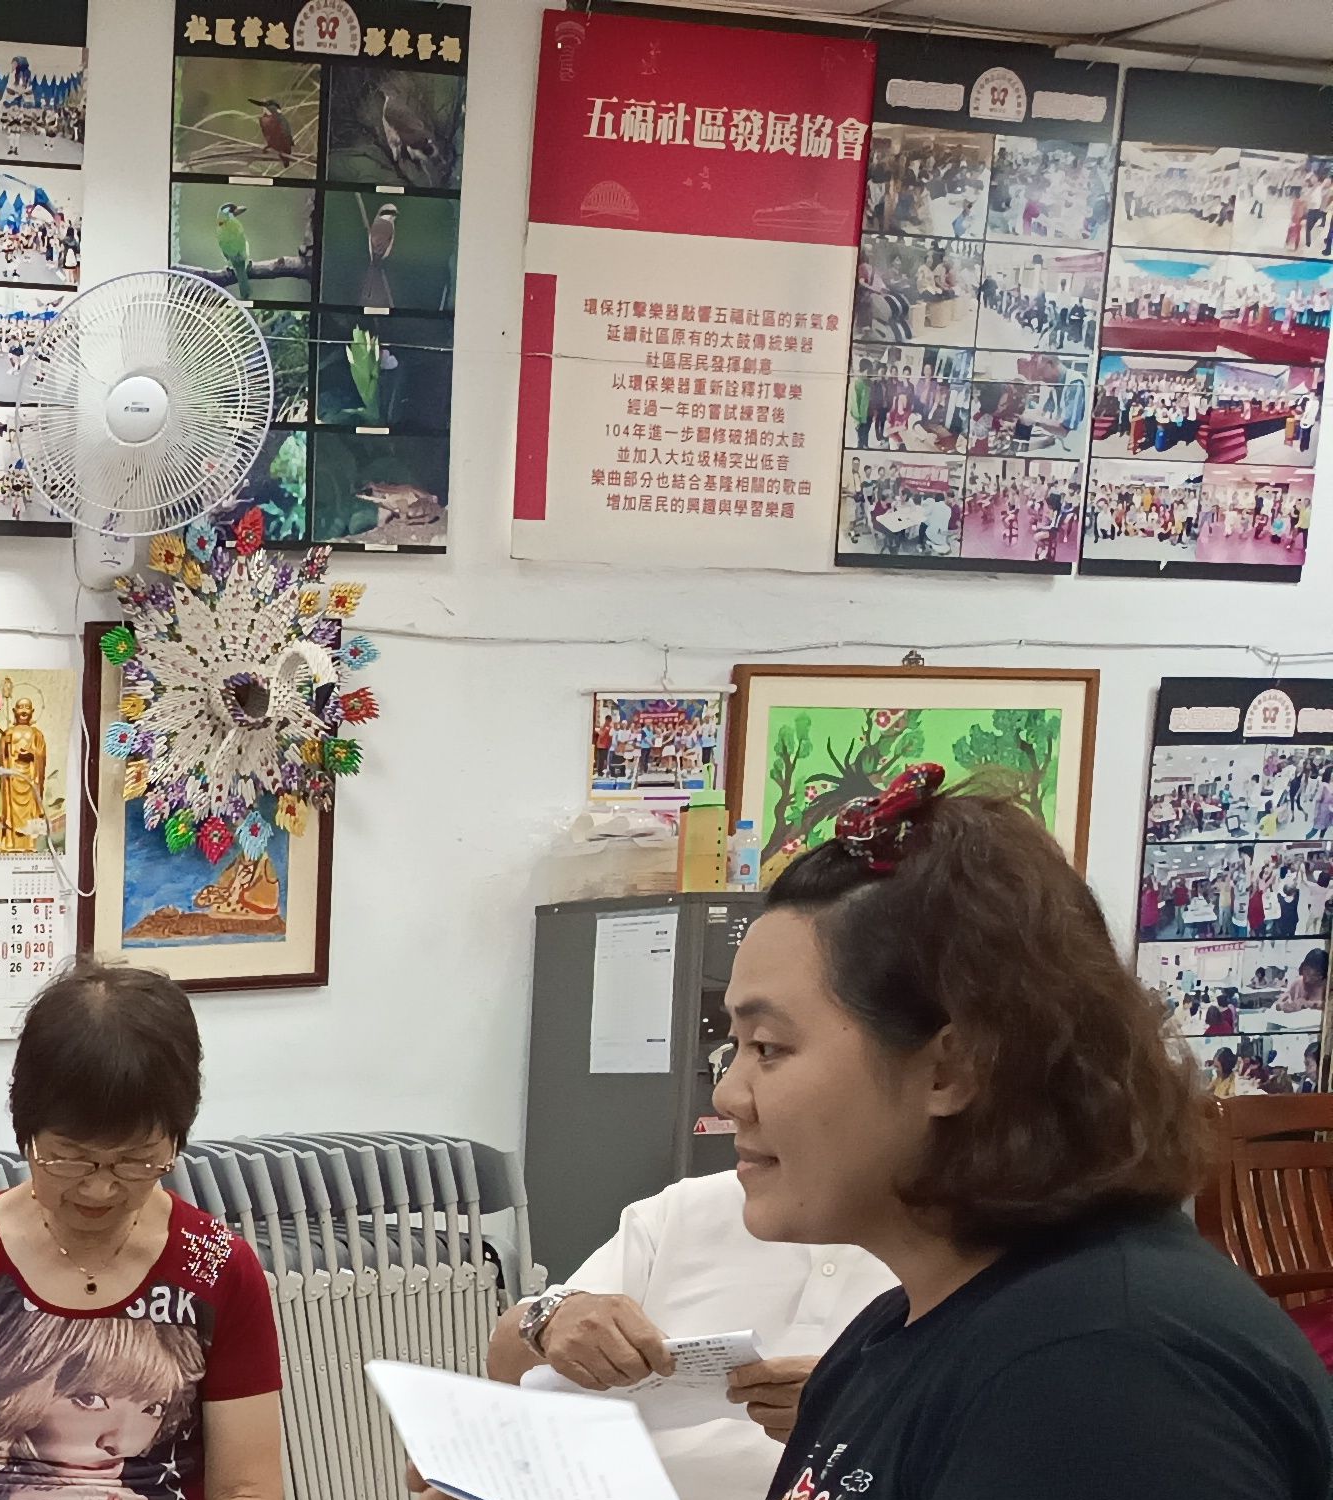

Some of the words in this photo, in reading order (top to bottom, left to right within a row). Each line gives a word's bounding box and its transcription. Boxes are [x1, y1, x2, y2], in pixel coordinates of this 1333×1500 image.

[583, 96, 869, 161] 五福社區發展協會
[583, 298, 840, 331] 環保打擊樂器敲響五福社區的新氣象
[606, 324, 815, 354] 延續社區原有的太鼓傳統樂器
[645, 352, 773, 376] 社區居民發揮創意
[611, 372, 803, 401] 以環保樂器重新詮釋打擊樂
[627, 398, 786, 424] 經過一年的嘗試練習後
[617, 447, 791, 472] 並加入大垃圾桶突出低音
[591, 469, 813, 497] 樂曲部分也結合基隆相關的歌曲
[606, 493, 796, 519] 增加居民的興趣與學習樂趣
[12, 906, 17, 915] 5
[34, 905, 39, 914] 6
[11, 925, 22, 934] 12
[34, 924, 45, 933] 13
[11, 944, 22, 953] 19
[34, 943, 45, 952] 20
[10, 964, 21, 972] 26
[33, 962, 45, 971] 27
